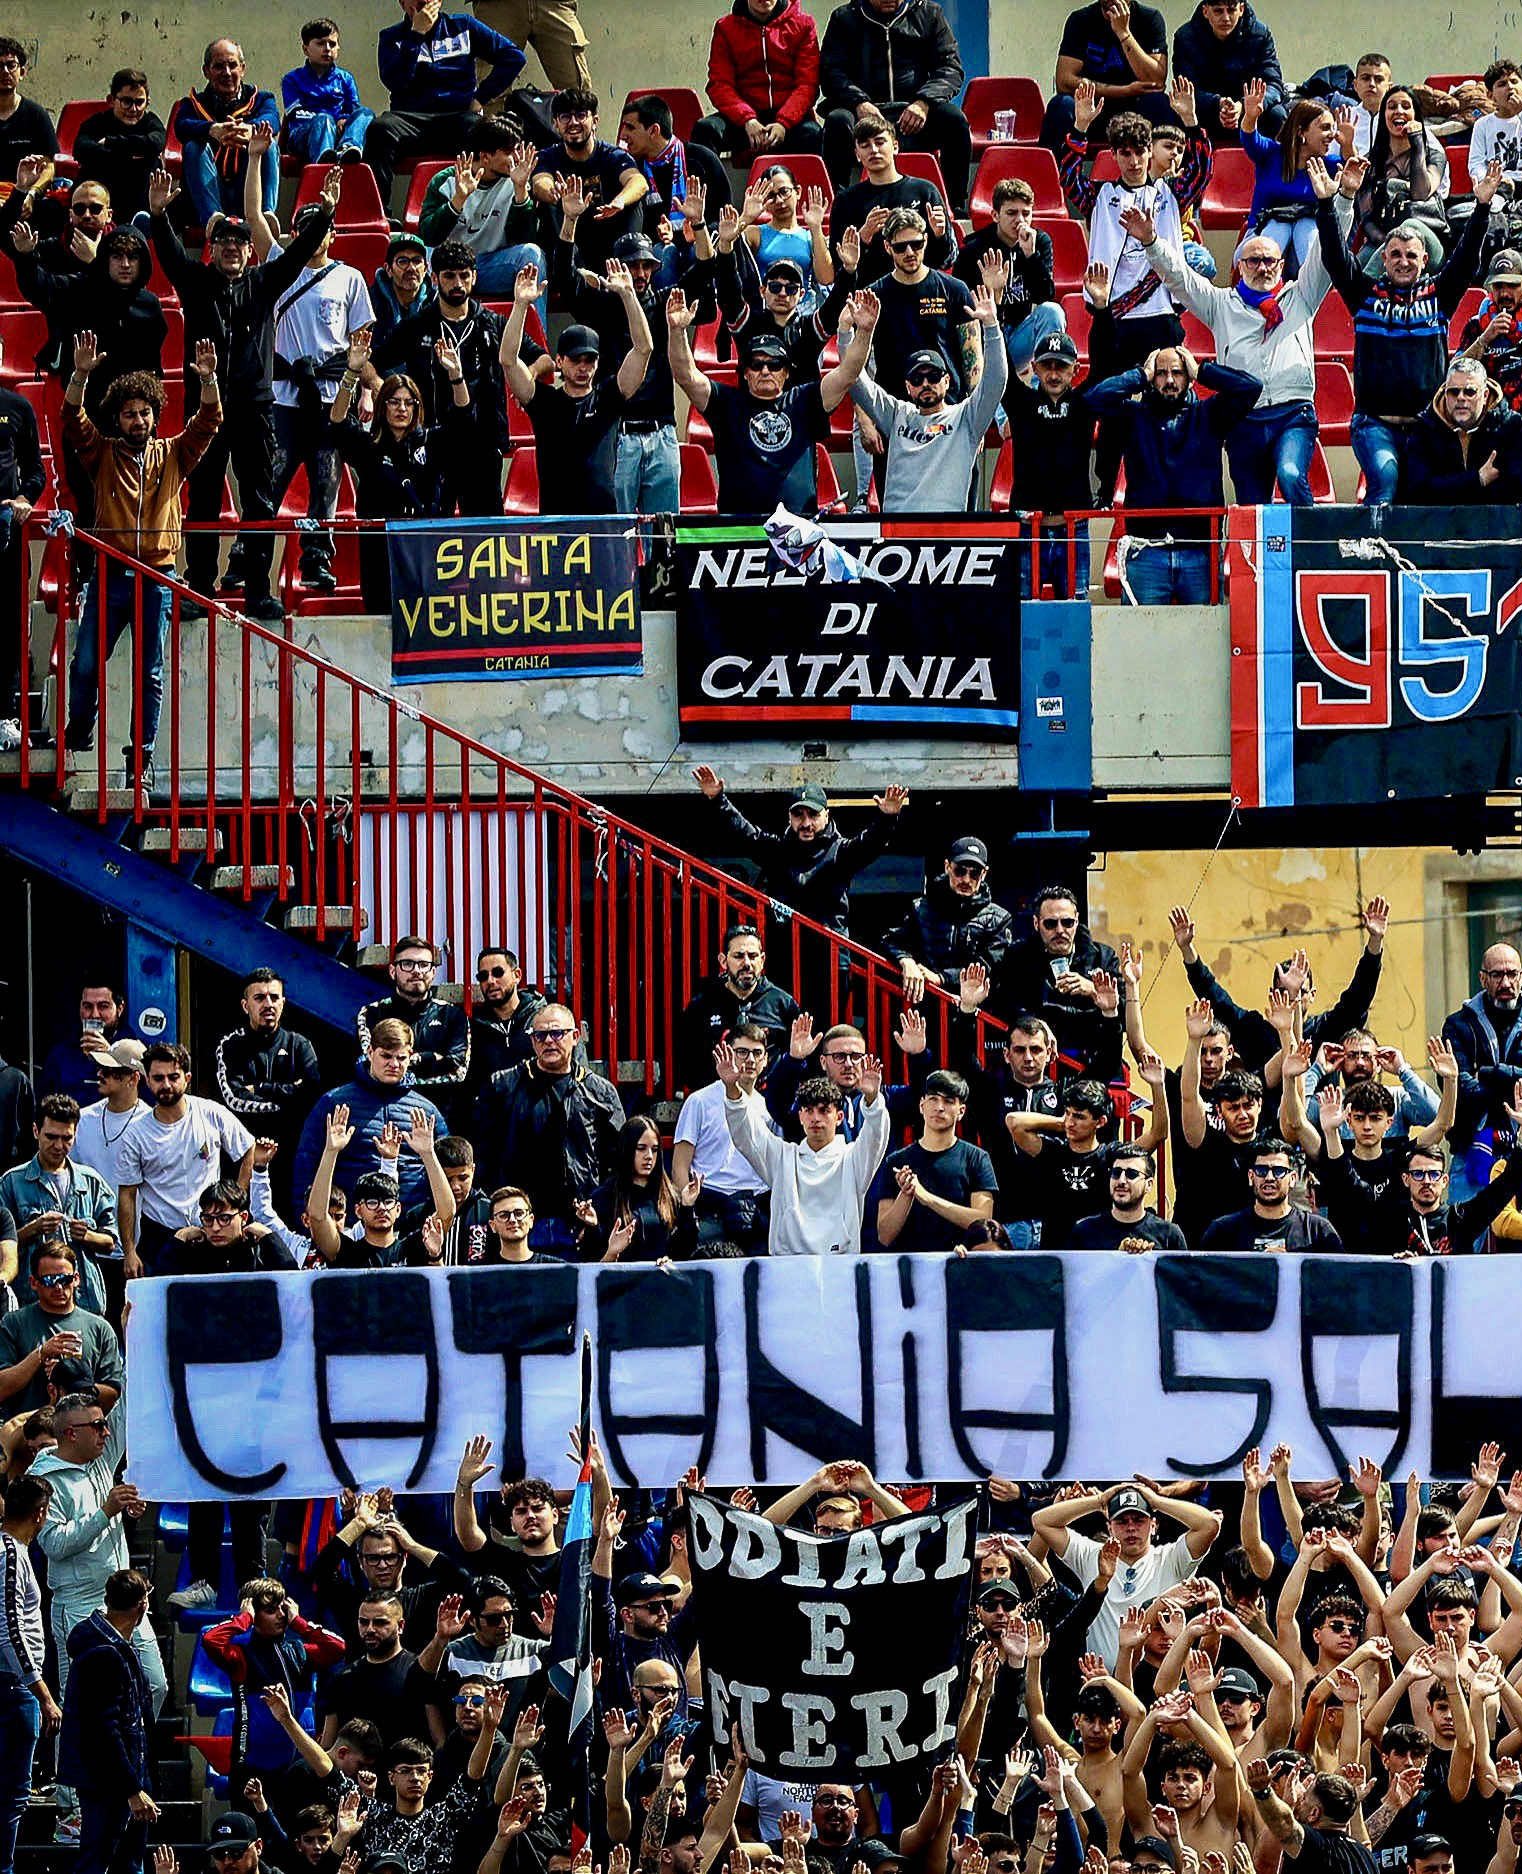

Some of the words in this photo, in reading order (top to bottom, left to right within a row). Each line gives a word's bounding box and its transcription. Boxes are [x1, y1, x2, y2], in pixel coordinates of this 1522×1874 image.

[436, 533, 591, 580] SANTA
[399, 589, 635, 638] VENERINA
[821, 602, 877, 635] DI
[485, 655, 550, 671] CATANIA
[700, 653, 997, 701] CATANIA
[689, 1495, 978, 1589] ODIATI
[798, 1601, 854, 1675] E
[707, 1666, 959, 1768] FIERI
[782, 1785, 817, 1797] NORTH
